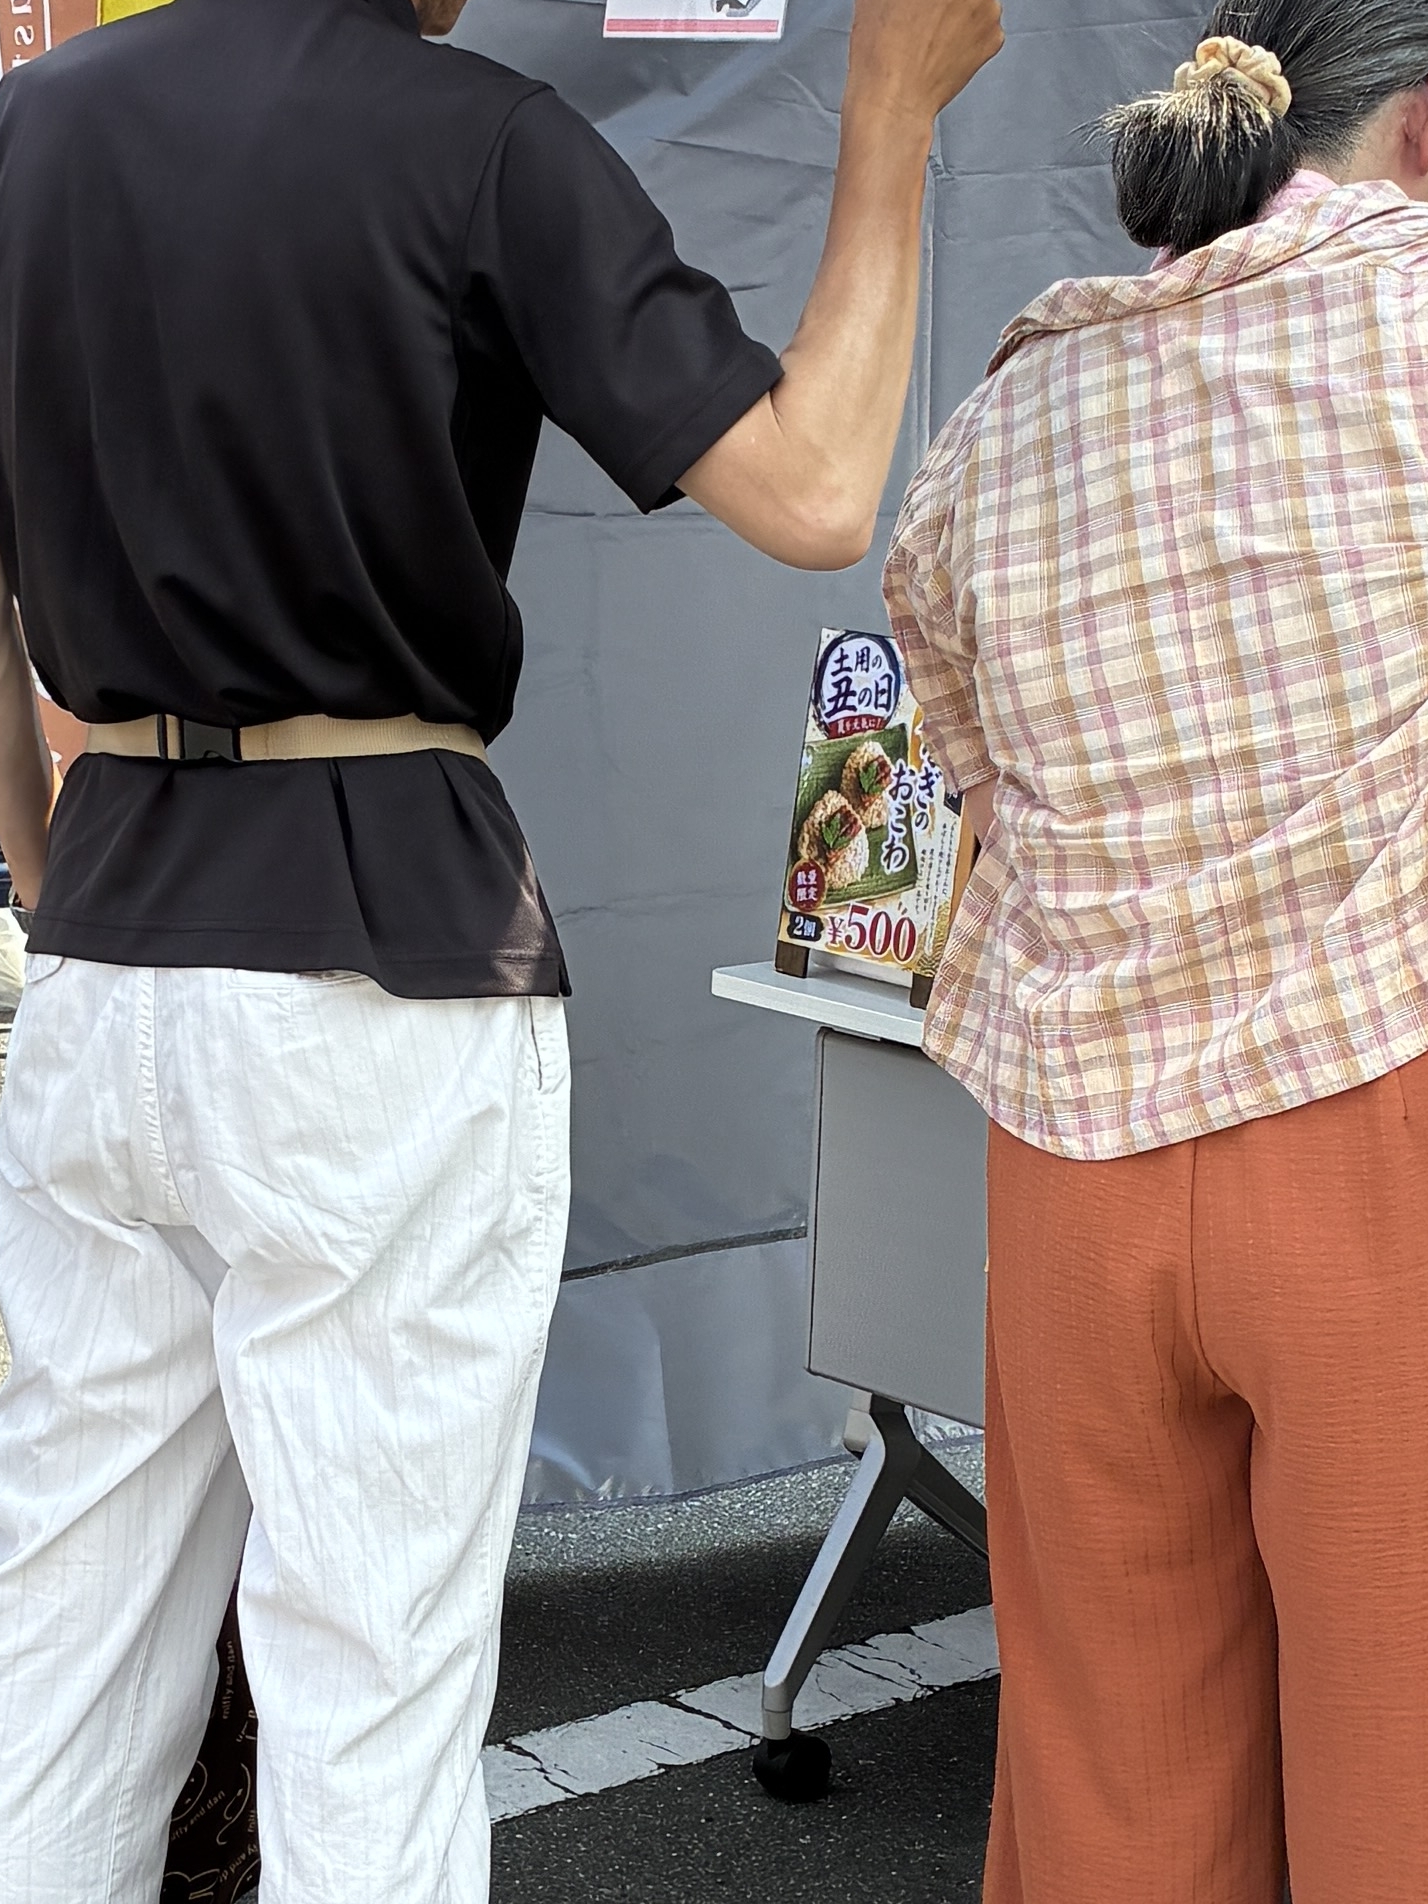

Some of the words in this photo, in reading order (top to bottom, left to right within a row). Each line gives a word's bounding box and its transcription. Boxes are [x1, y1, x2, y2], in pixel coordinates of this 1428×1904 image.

[830, 645, 883, 677] 土用の
[824, 673, 893, 719] 丑の日
[883, 763, 916, 871] おこわ
[827, 904, 917, 962] ¥500
